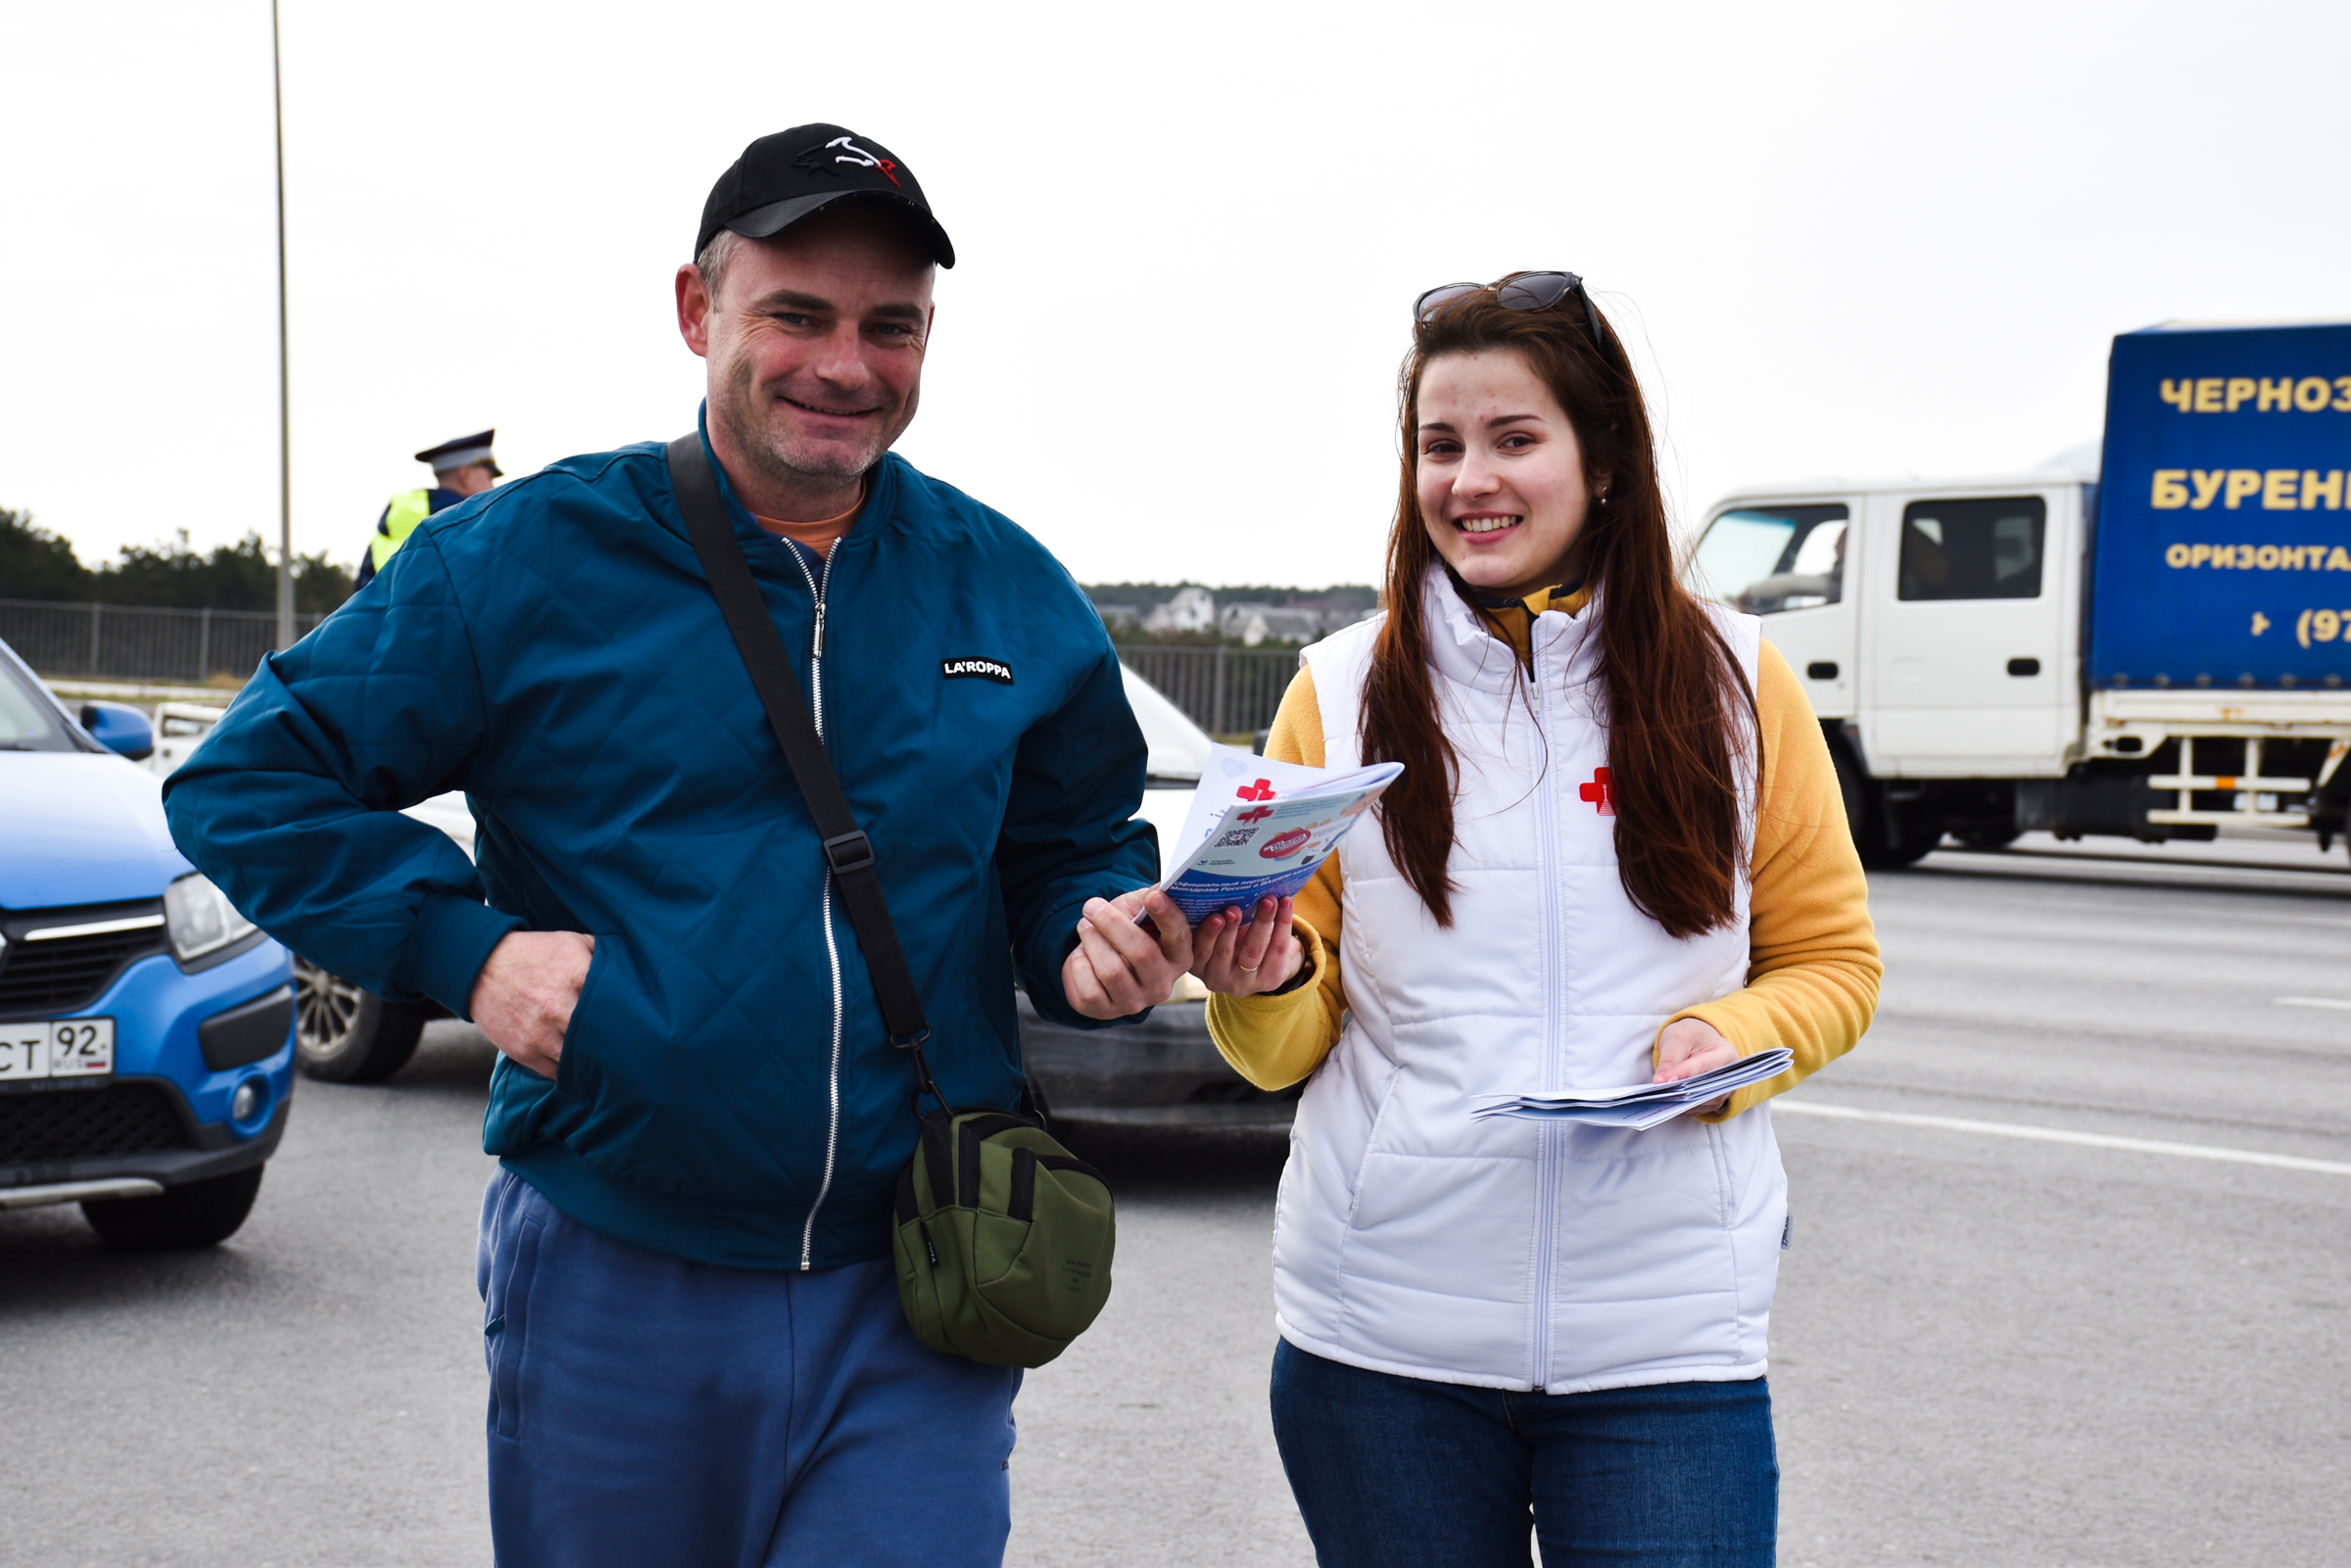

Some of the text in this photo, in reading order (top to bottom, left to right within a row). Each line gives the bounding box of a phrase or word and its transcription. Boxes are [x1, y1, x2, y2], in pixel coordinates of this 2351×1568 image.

[2150, 469, 2351, 510] БУРЕН
[944, 660, 1011, 679] LA'ROPPA
[57, 1025, 97, 1057] 92
